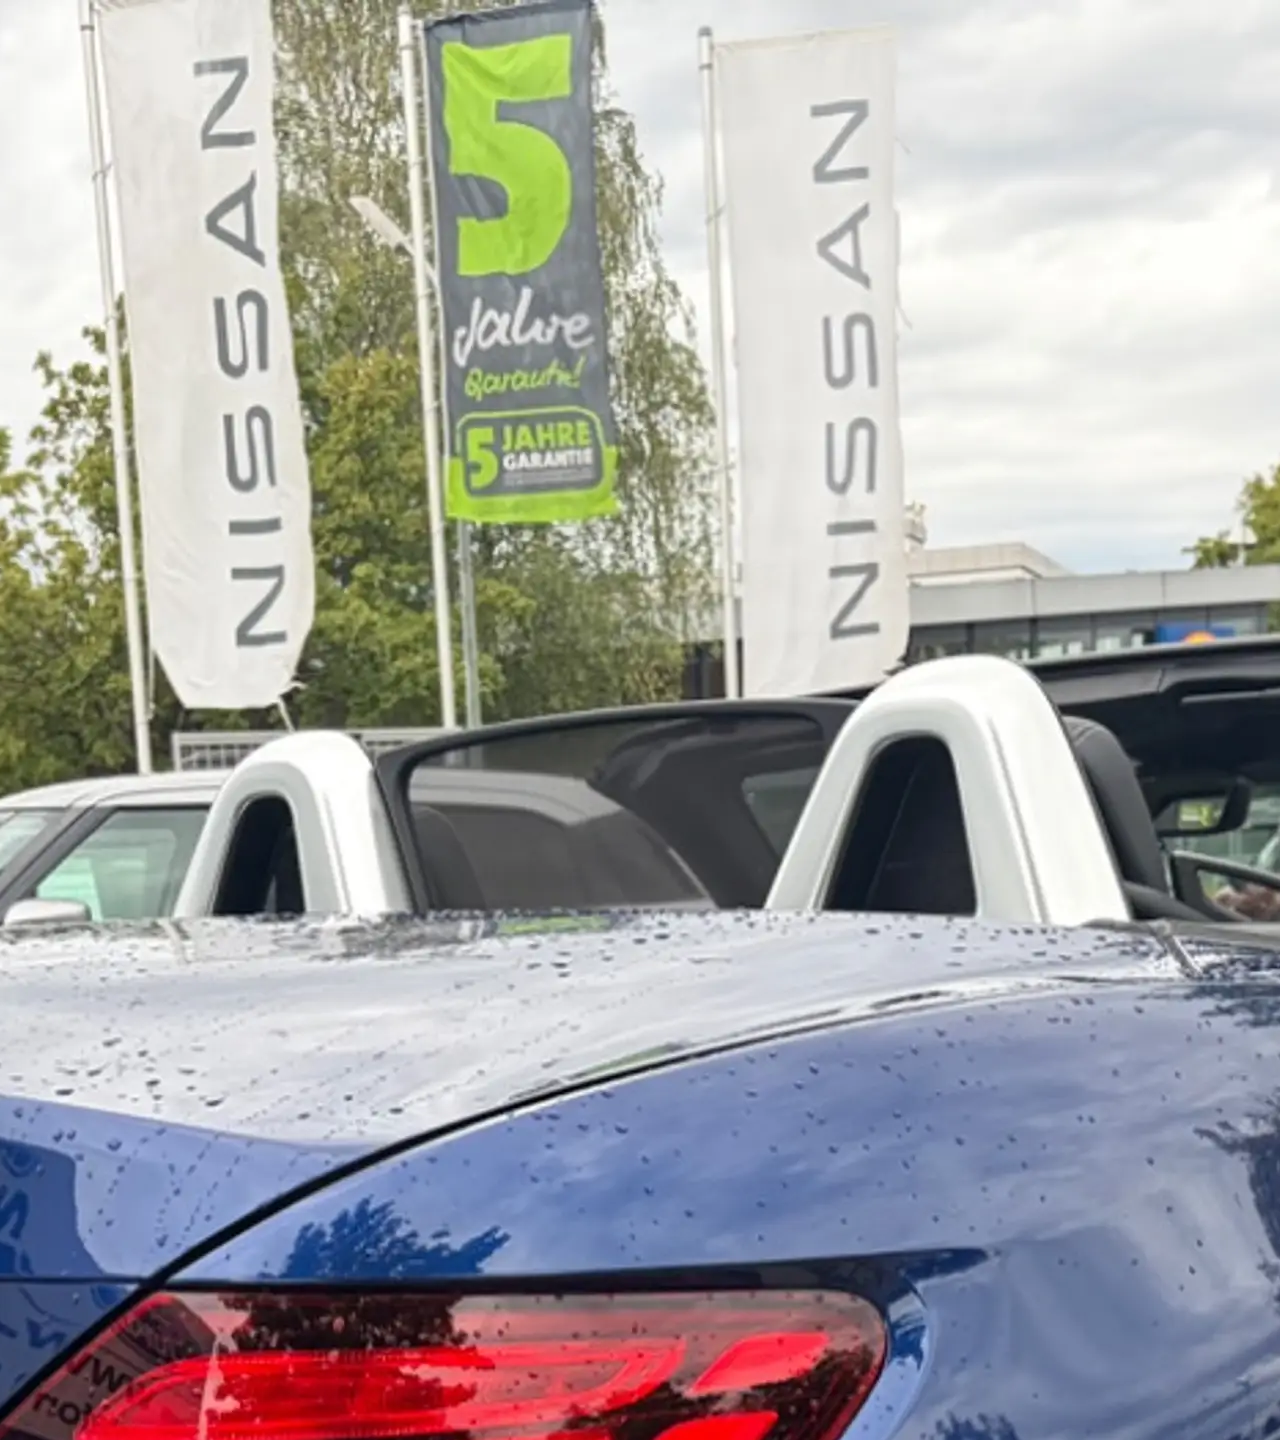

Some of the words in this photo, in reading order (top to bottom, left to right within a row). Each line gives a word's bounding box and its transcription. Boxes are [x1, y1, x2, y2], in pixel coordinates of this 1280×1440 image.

[441, 35, 572, 277] 5
[193, 55, 287, 648] NISSAN
[453, 286, 595, 367] Jahre
[810, 98, 881, 641] NISSAN
[467, 426, 498, 489] 5
[502, 421, 592, 450] JAHRE
[503, 448, 593, 471] GARANTIE
